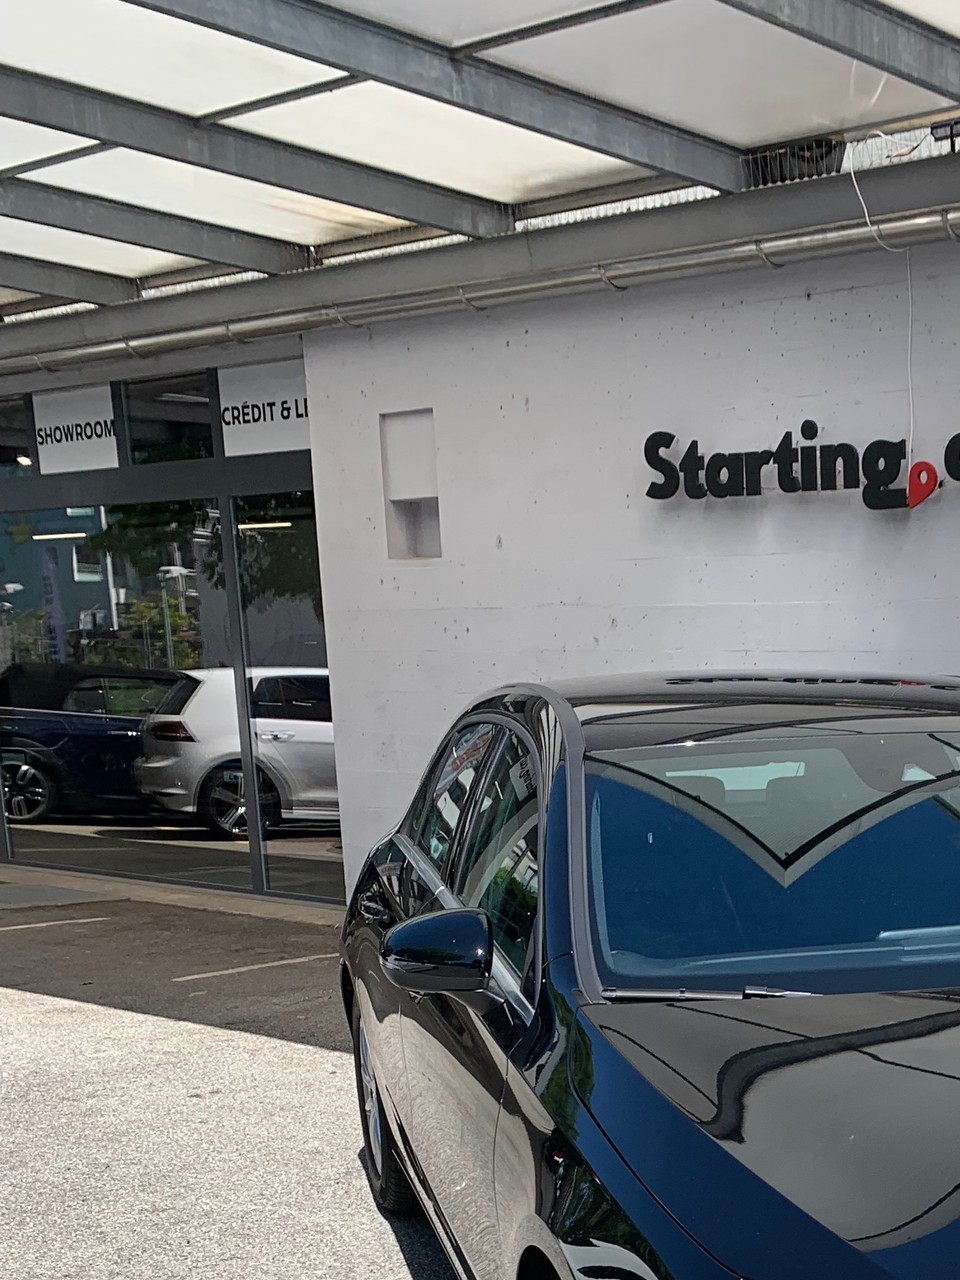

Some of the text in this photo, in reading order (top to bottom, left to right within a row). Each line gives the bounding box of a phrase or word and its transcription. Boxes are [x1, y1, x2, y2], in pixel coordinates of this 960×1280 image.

[221, 400, 277, 426] CRÉDIT
[280, 399, 292, 420] &
[37, 418, 118, 446] SHOWROOM
[643, 418, 909, 511] Starting
